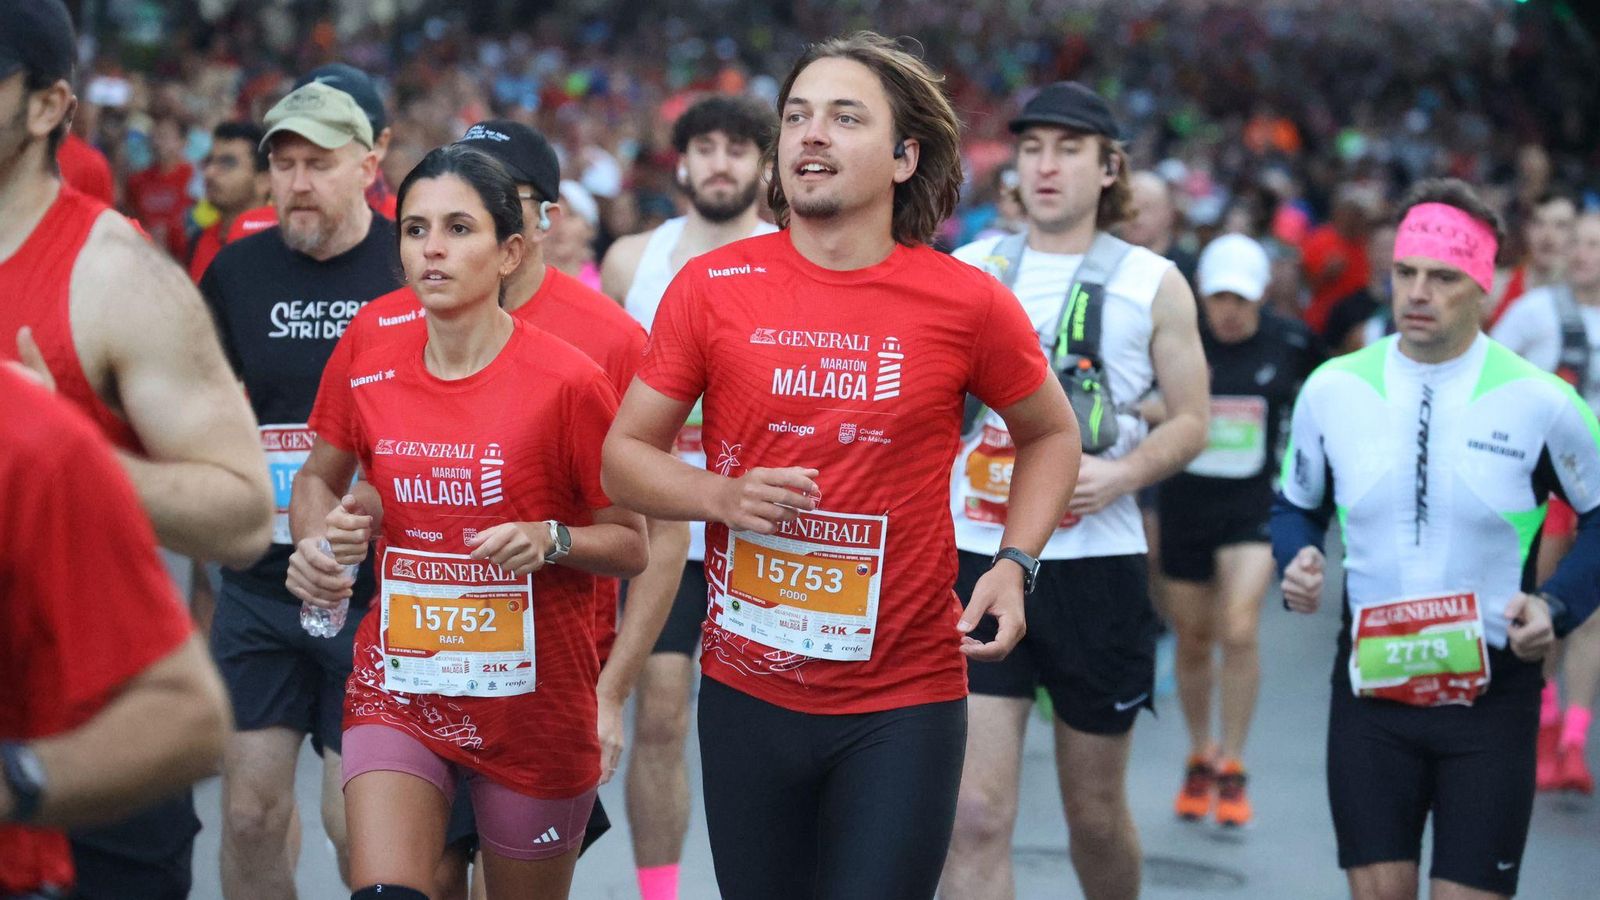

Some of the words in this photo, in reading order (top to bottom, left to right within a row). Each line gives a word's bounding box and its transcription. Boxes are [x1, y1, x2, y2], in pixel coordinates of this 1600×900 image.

[708, 264, 751, 278] luanvi
[269, 300, 368, 323] SEAFOR
[379, 310, 416, 327] luanvi
[268, 315, 349, 339] STRIDE
[778, 330, 870, 352] GENERALI
[820, 357, 868, 372] MARATÓN
[350, 371, 383, 388] luanvi
[771, 365, 868, 401] MÁLAGA
[859, 427, 884, 436] Ciudad
[395, 441, 475, 460] GENERALI
[432, 466, 472, 480] MARATÓN
[393, 474, 478, 507] MÁLAGA
[777, 517, 872, 545] ENERALI
[417, 561, 518, 582] GENERALI
[755, 553, 843, 593] 15753
[779, 588, 808, 602] PODO
[412, 604, 497, 632] 15752
[820, 624, 847, 636] 21K
[439, 635, 465, 645] RAFA
[1385, 638, 1449, 664] 2778
[482, 663, 509, 673] 21K
